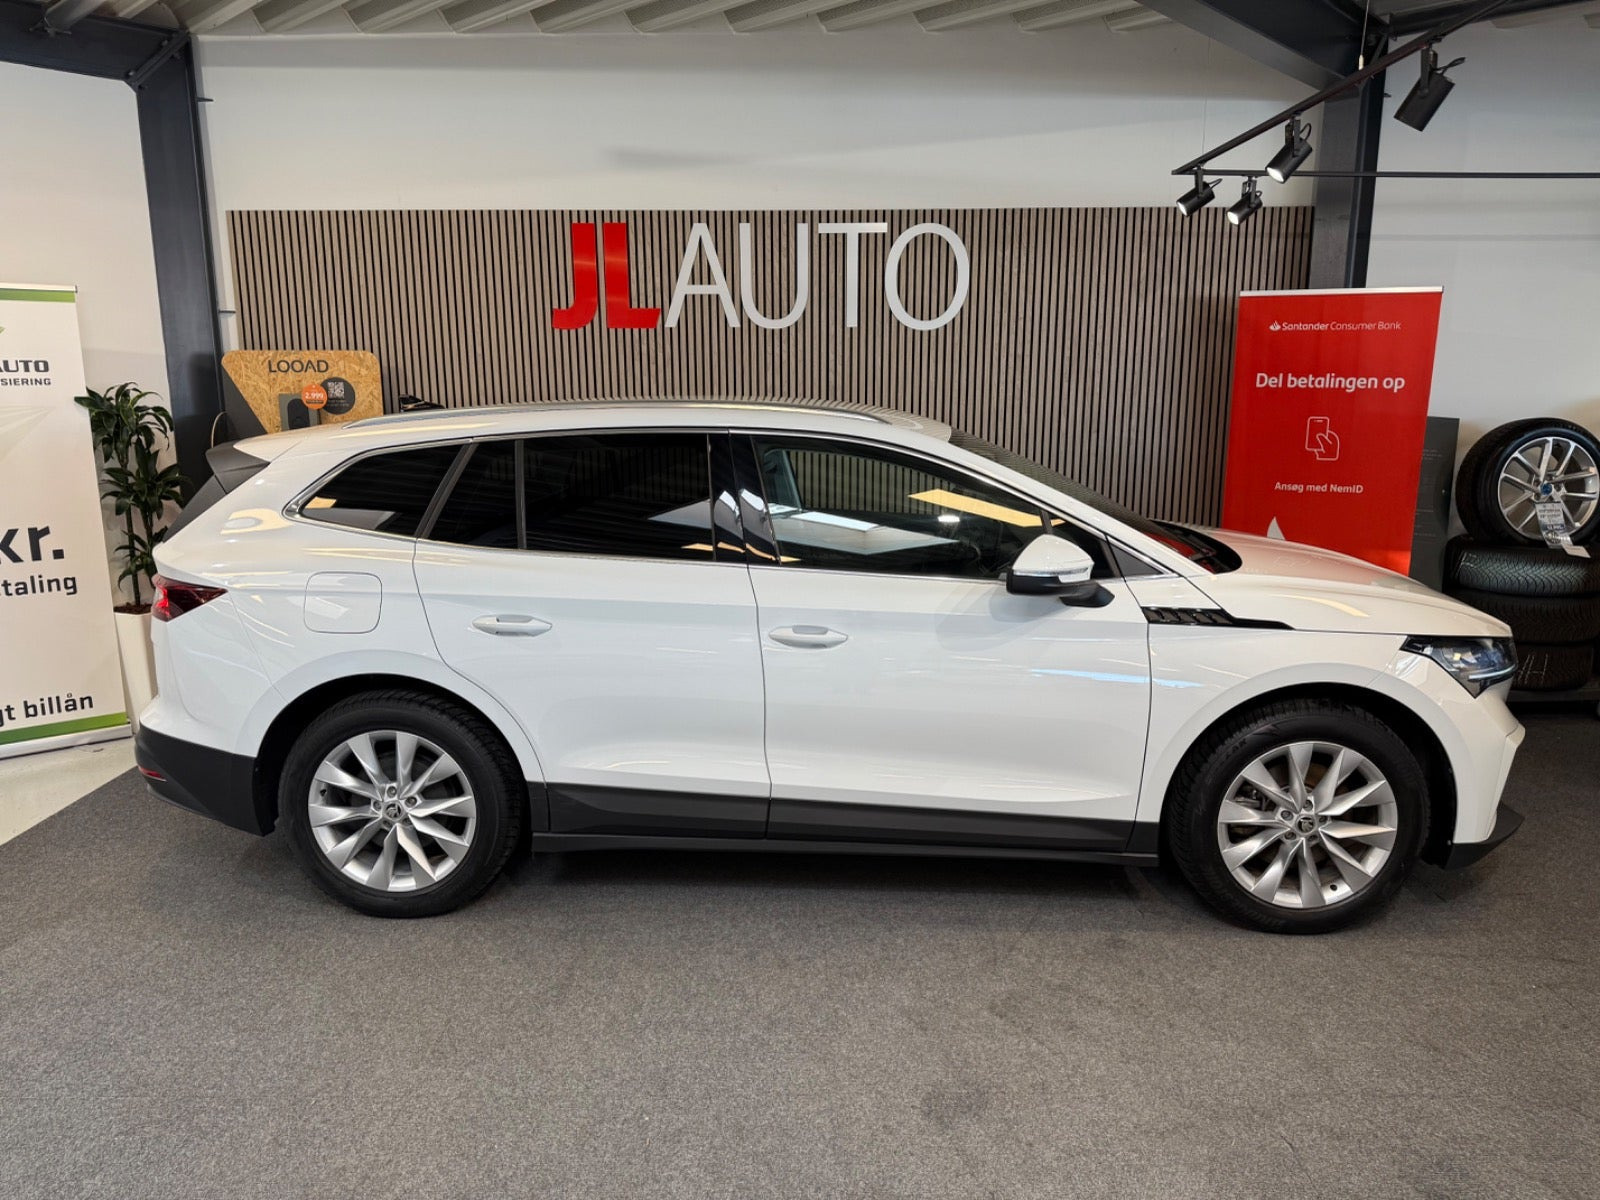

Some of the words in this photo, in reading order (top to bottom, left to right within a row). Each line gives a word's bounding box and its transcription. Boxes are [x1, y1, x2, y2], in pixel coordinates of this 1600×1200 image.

[1282, 322, 1329, 331] Santander
[1330, 321, 1376, 331] Consumer
[1378, 321, 1401, 330] Bank
[0, 359, 49, 373] UTO
[268, 359, 329, 373] LOOAD
[1255, 373, 1283, 389] Del
[1287, 373, 1378, 393] betalingen
[1383, 377, 1405, 393] op
[1275, 482, 1304, 493] Ansøg
[1306, 484, 1327, 492] med
[1330, 484, 1364, 493] NemID
[23, 692, 94, 718] billån
